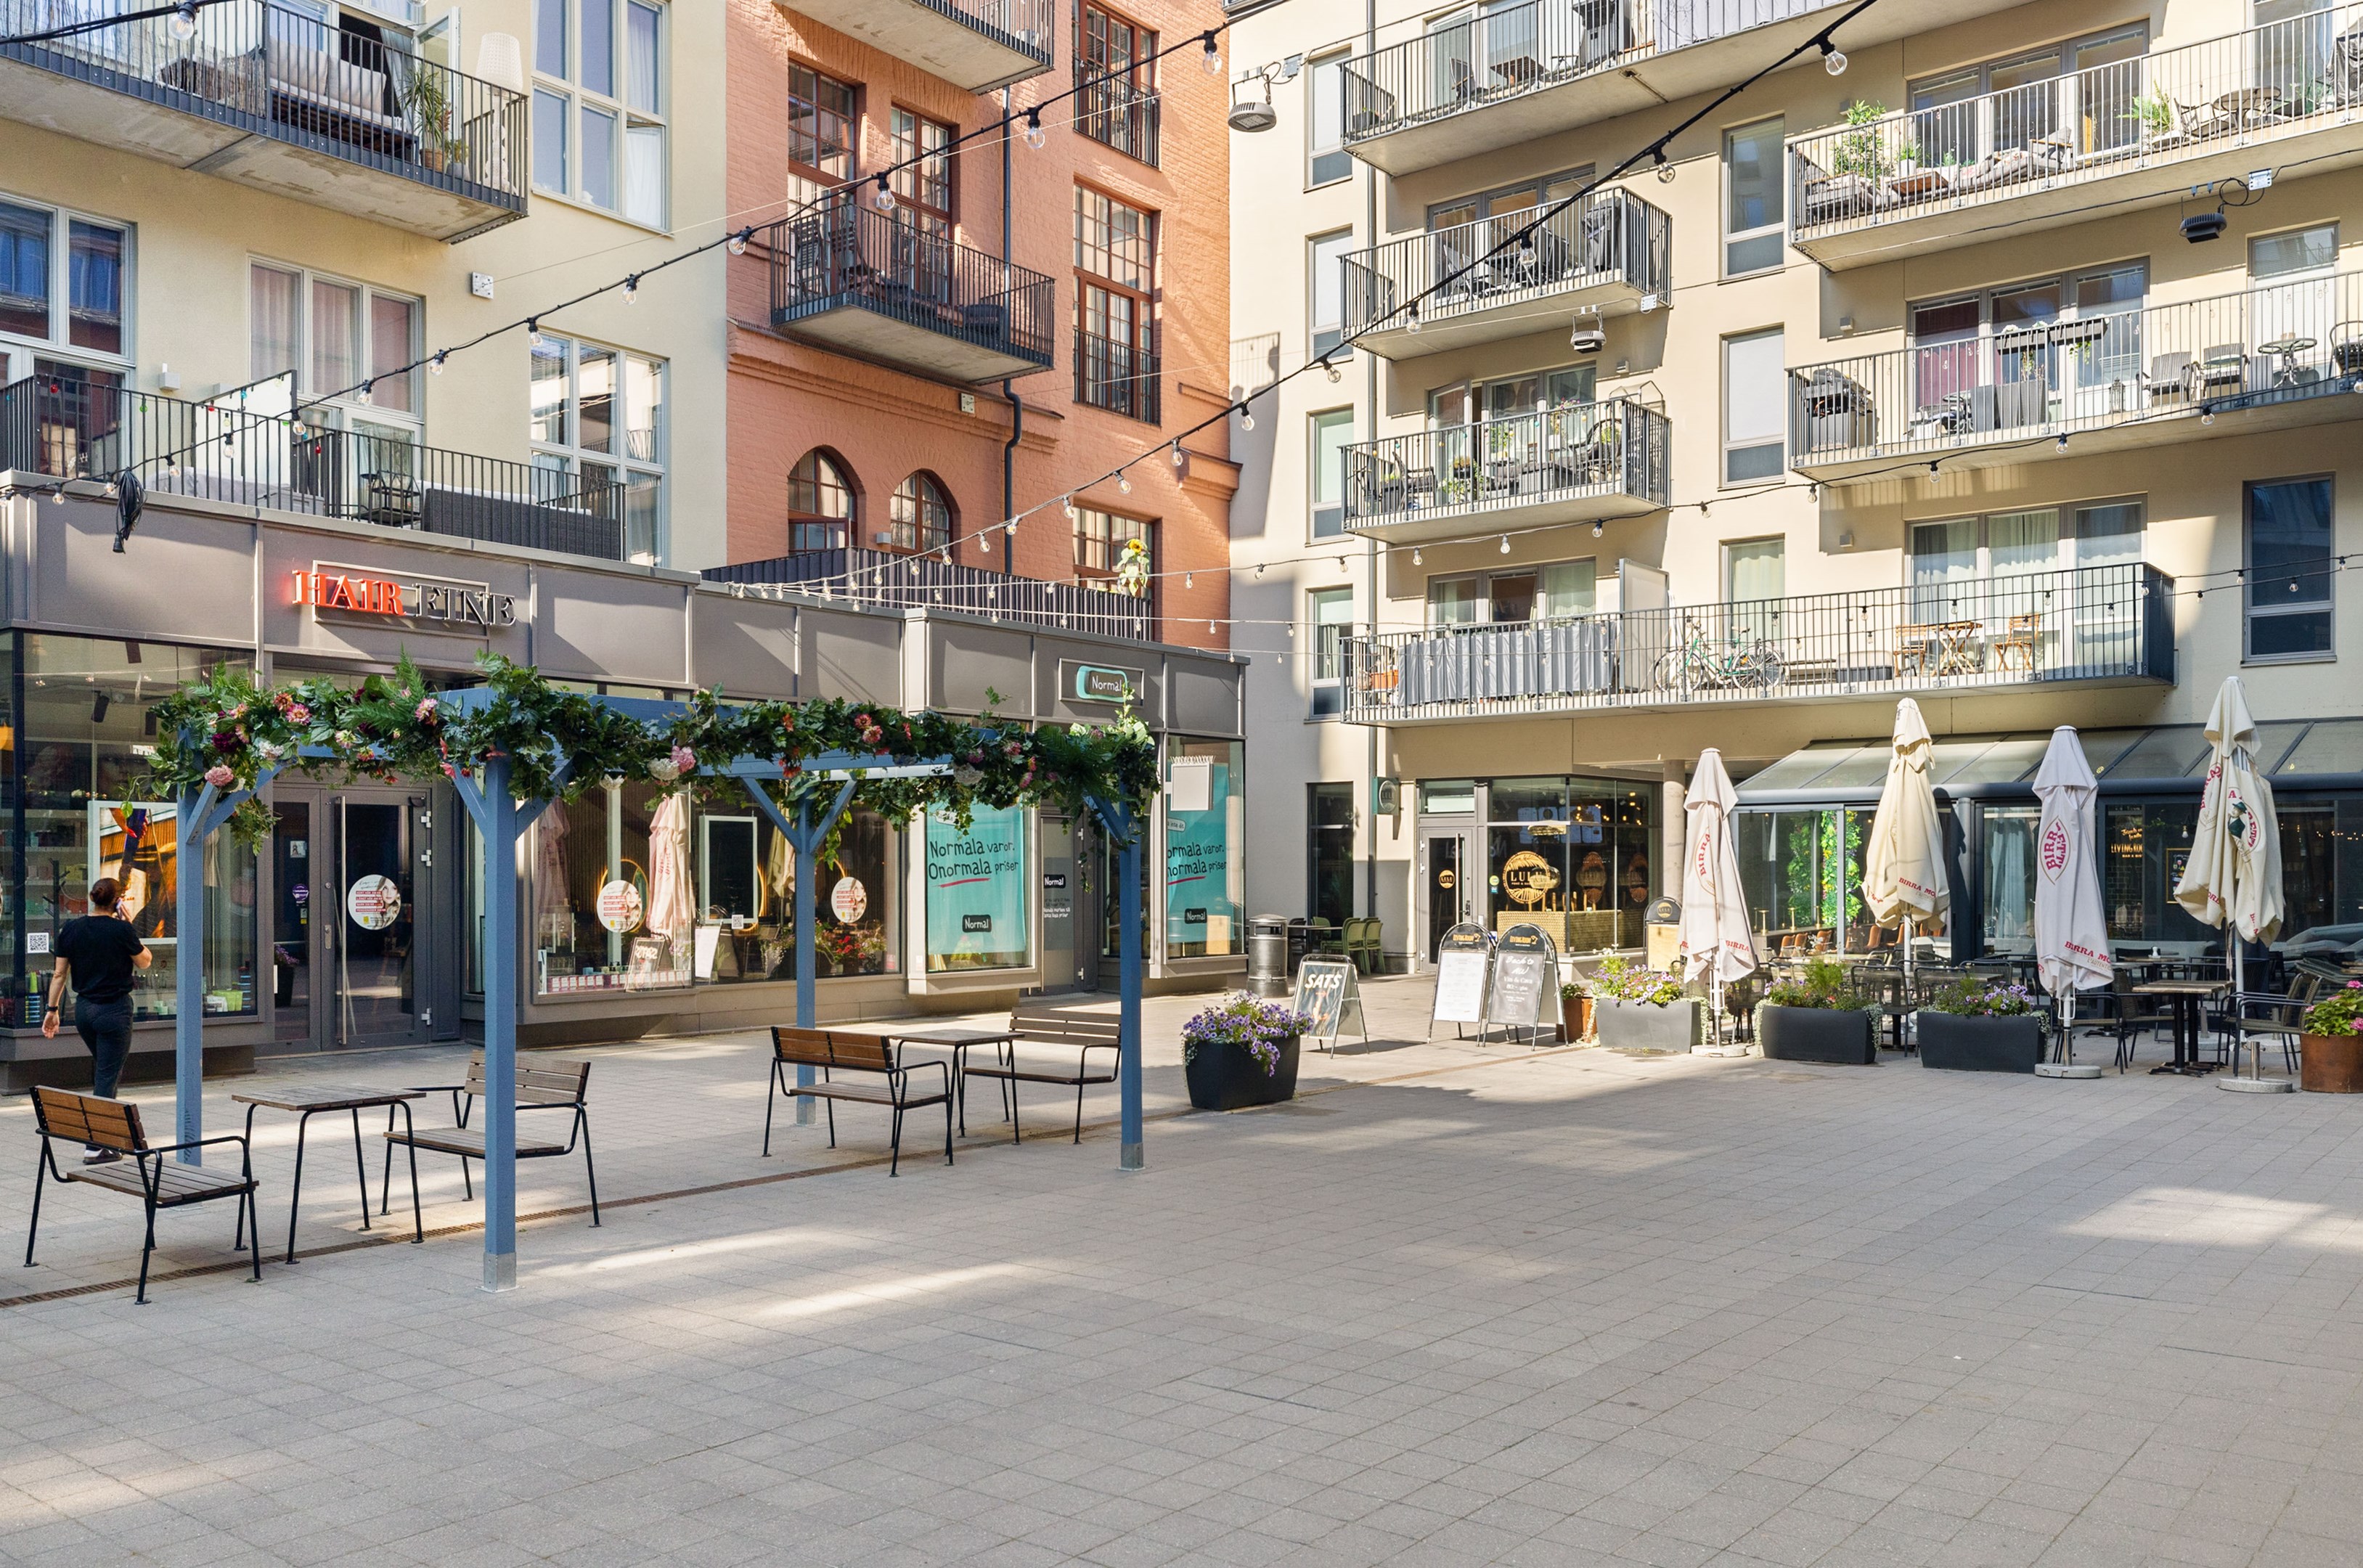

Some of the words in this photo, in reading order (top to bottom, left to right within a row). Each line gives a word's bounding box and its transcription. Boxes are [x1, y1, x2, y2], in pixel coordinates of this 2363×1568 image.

[292, 570, 407, 616] HAIR
[412, 583, 517, 626] FINE
[1092, 675, 1122, 691] Normal
[930, 838, 985, 858] Normala
[987, 841, 1015, 853] varor.
[1167, 842, 1202, 859] ormala
[1202, 844, 1225, 855] varor.
[929, 858, 992, 880] Onormala
[995, 861, 1019, 875] priser
[1167, 859, 1207, 877] normala
[1208, 861, 1227, 873] priser
[1044, 876, 1064, 886] Normal
[1511, 872, 1542, 882] LULU
[1898, 877, 1922, 891] BIRRA
[965, 918, 989, 929] Normal
[1187, 911, 1206, 921] Normal
[1726, 939, 1750, 952] BIRRA
[2065, 941, 2094, 957] BIRRA
[1305, 973, 1342, 989] SATS
